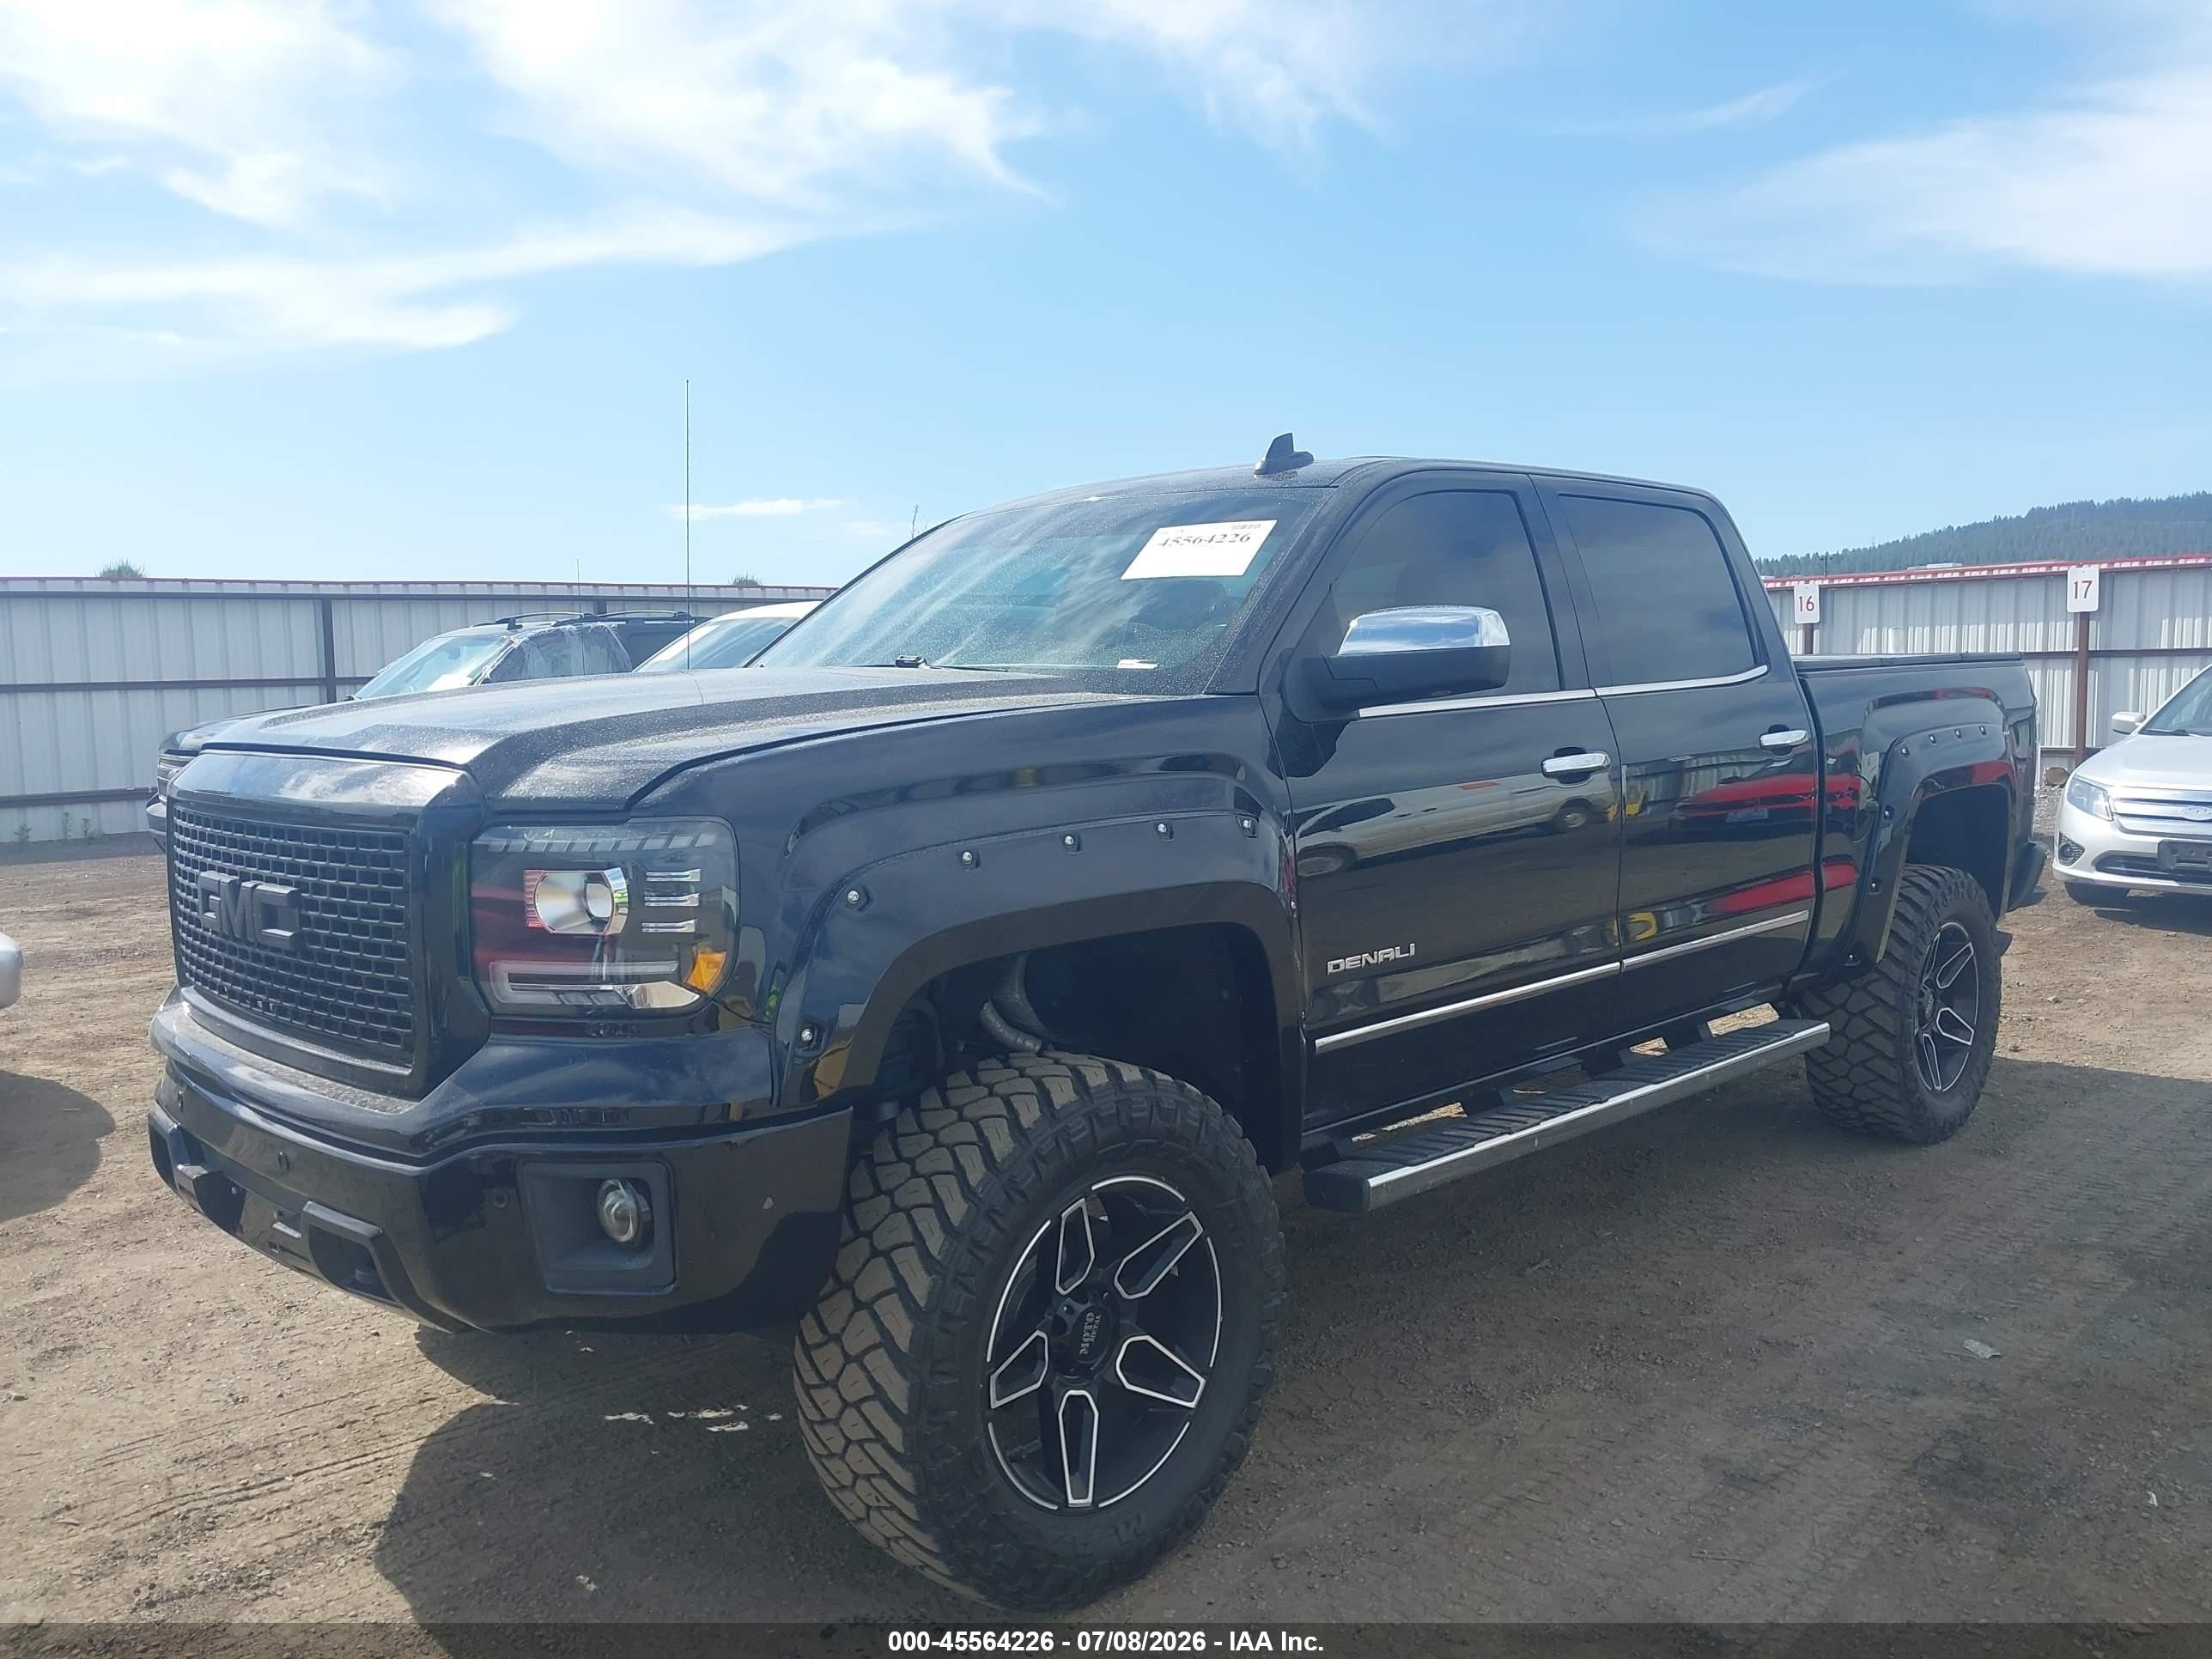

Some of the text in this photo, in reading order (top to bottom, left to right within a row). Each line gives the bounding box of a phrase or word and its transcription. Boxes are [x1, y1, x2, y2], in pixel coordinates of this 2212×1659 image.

[1157, 532, 1251, 547] 45564226
[2072, 580, 2093, 599] 17
[1798, 595, 1815, 612] 16
[198, 871, 301, 951] GMC
[1327, 943, 1415, 975] DENALI
